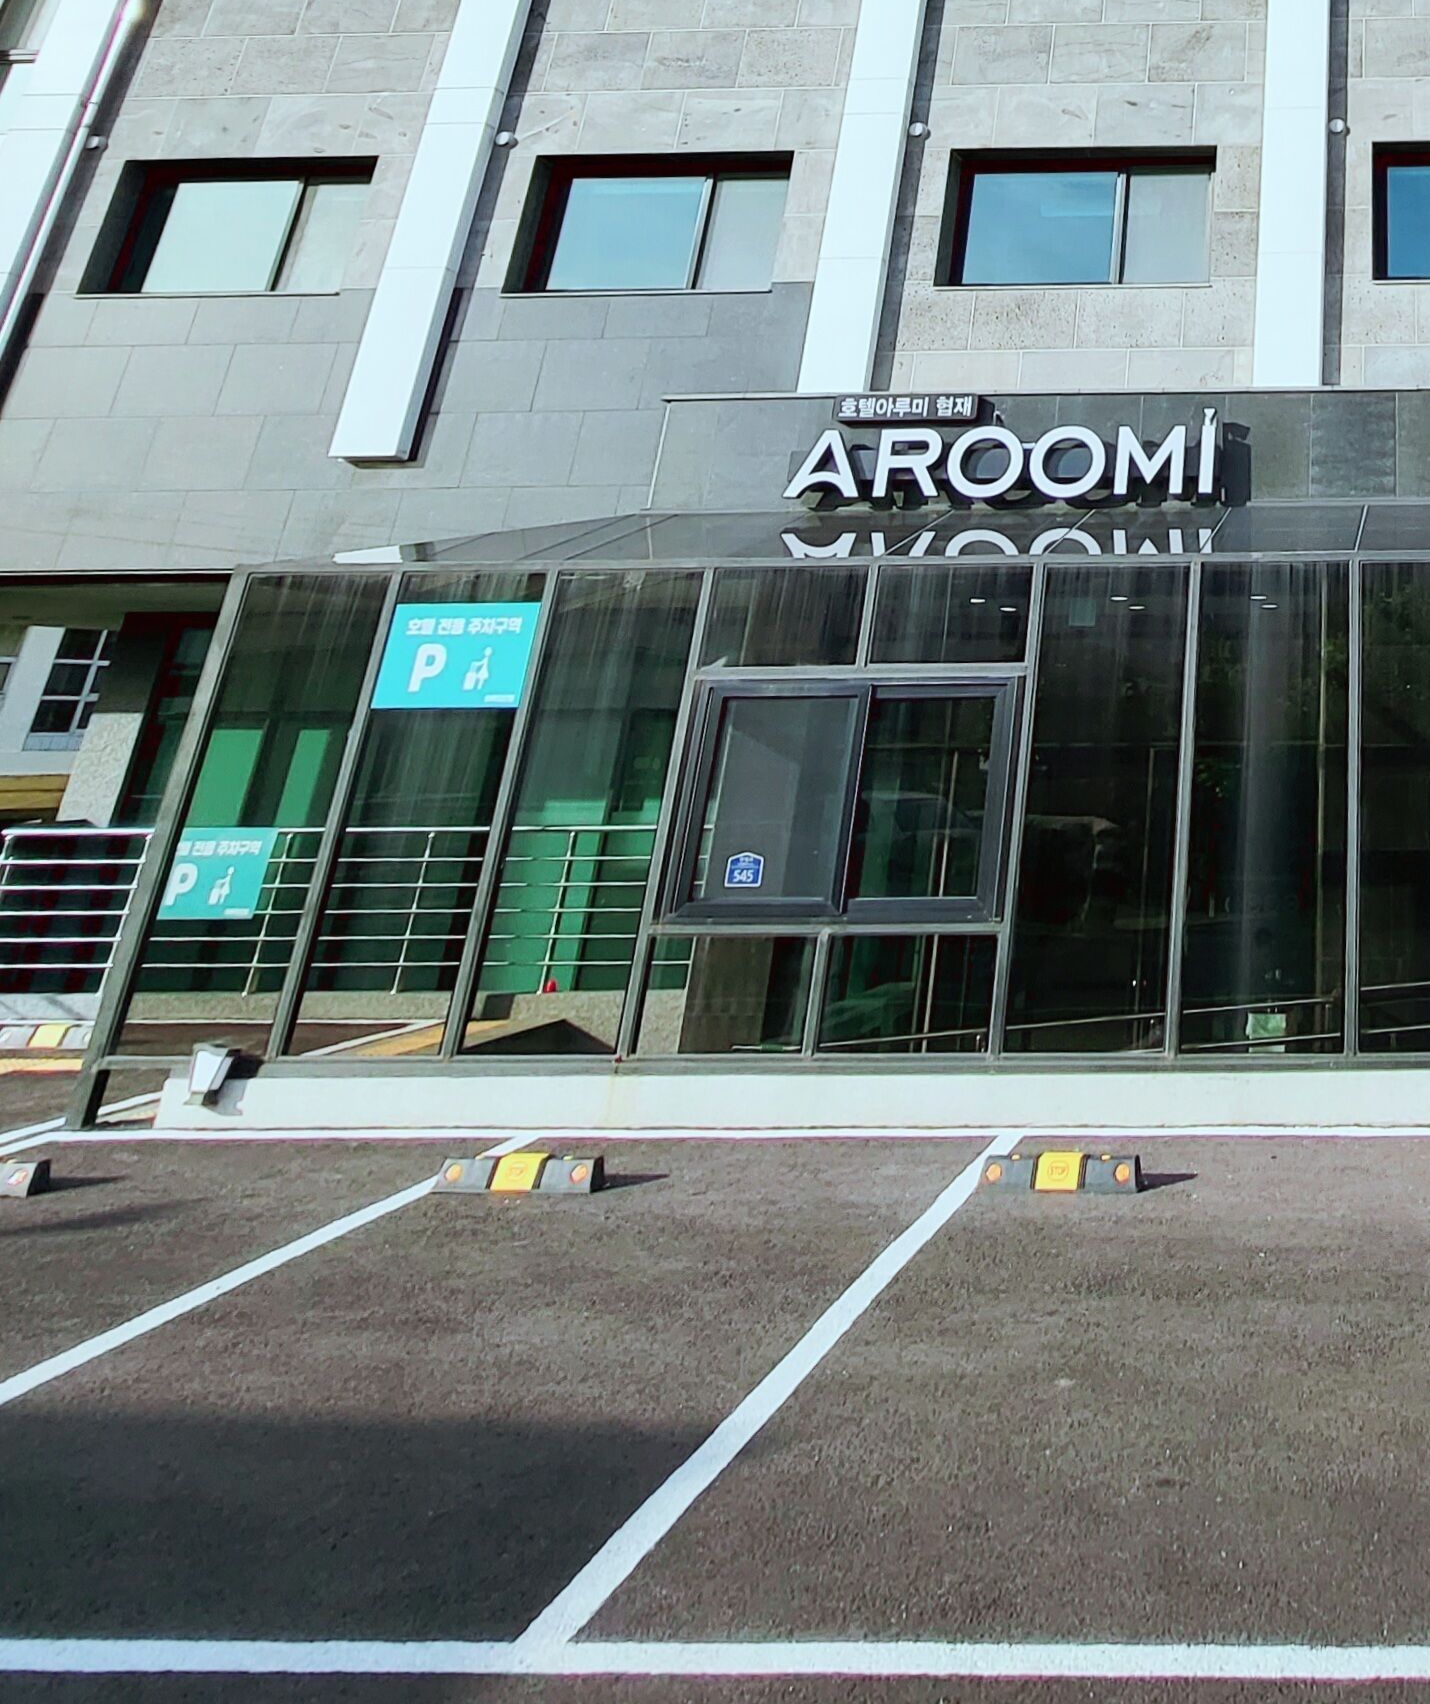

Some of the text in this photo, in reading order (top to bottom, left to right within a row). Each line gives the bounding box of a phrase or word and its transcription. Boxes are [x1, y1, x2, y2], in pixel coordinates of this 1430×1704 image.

[838, 396, 972, 417] 호텔아루미 협재
[782, 408, 1217, 499] AROOMI
[468, 617, 522, 634] 주차구역
[407, 643, 447, 692] P
[163, 863, 198, 906] P
[732, 869, 754, 882] 545
